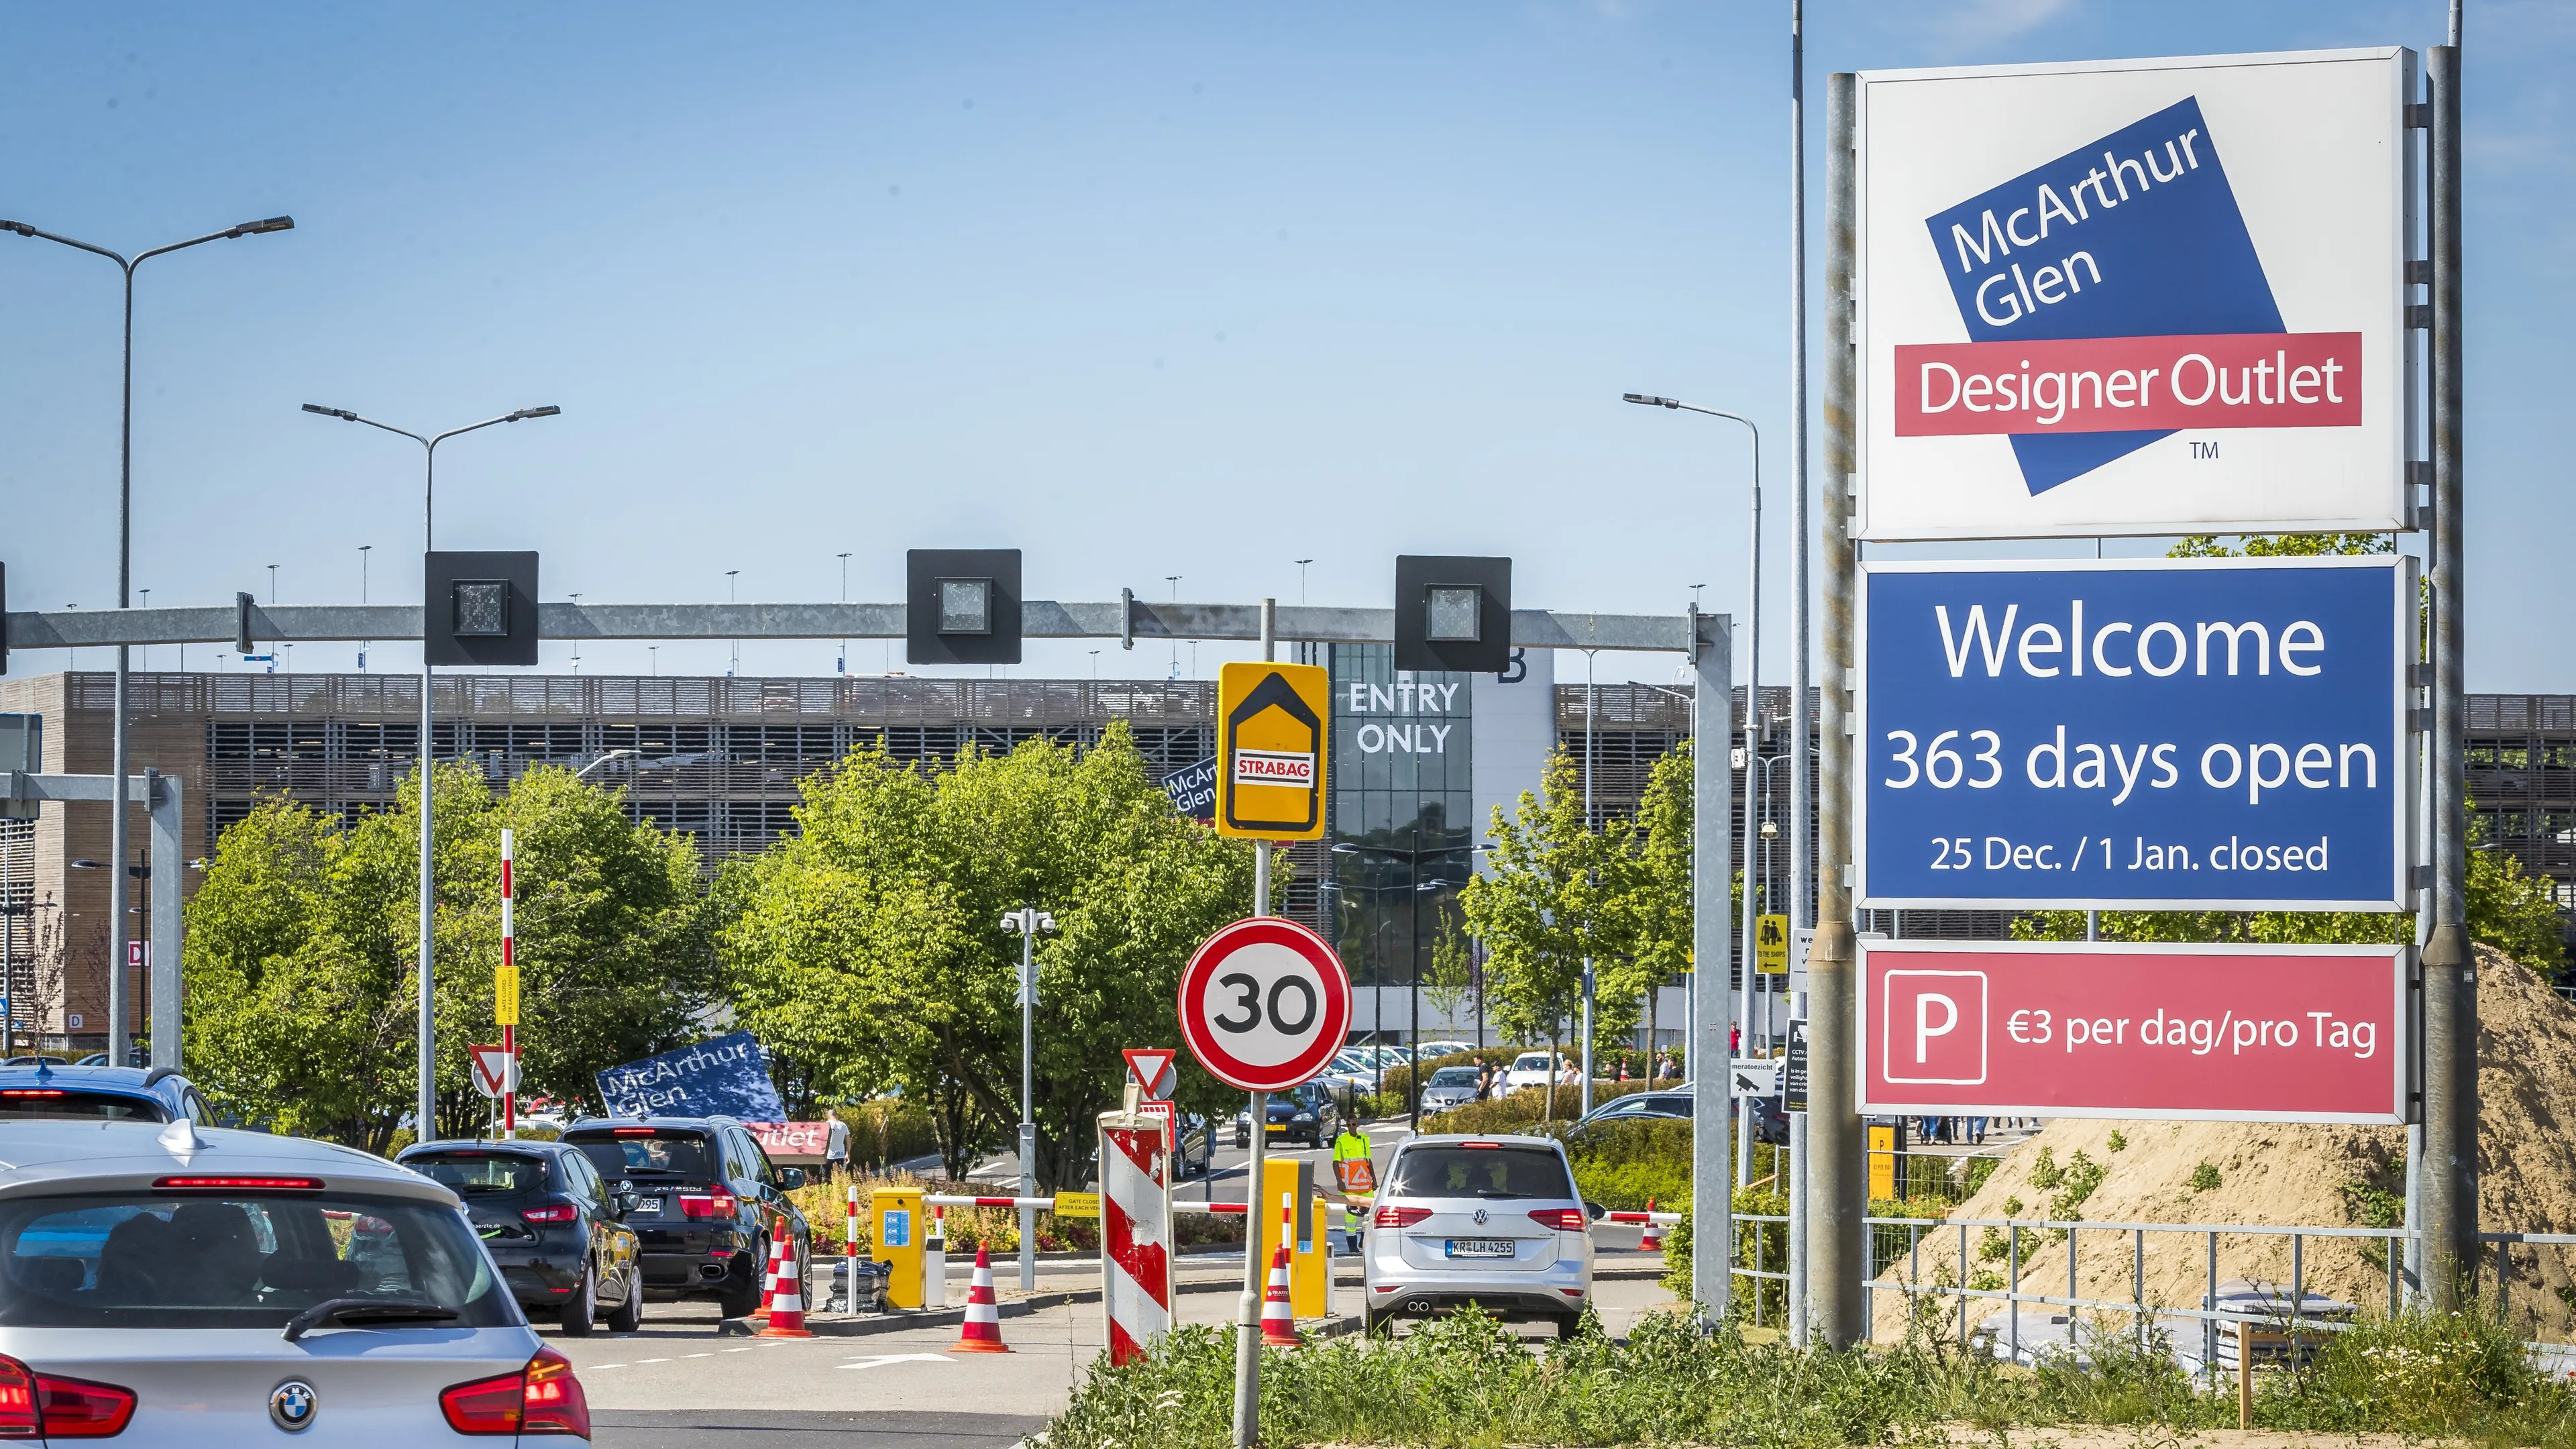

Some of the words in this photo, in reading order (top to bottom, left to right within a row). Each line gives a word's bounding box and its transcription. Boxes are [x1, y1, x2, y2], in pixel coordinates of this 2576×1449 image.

[1951, 128, 2199, 274] McArthur
[1976, 250, 2102, 327] Glen
[1921, 359, 2159, 425] Designer
[2170, 350, 2343, 407] Outlet
[2189, 441, 2219, 460] TM
[1935, 599, 2325, 678] Welcome
[1350, 683, 1459, 712] ENTRY
[1357, 724, 1452, 753] ONLY
[1169, 763, 1218, 796] McArt
[1239, 759, 1310, 777] STRABAG
[1884, 729, 2002, 789] 363
[2026, 725, 2178, 807] days
[2200, 742, 2377, 805] open
[1176, 788, 1216, 812] Glen
[1930, 838, 1972, 871] 25
[1986, 838, 2062, 871] Dec.
[2071, 836, 2087, 873] /
[2100, 838, 2112, 870] 1
[2127, 837, 2199, 871] Jan.
[2210, 836, 2328, 871] closed
[1213, 973, 1318, 1036] 30
[72, 1016, 80, 1027] D
[1916, 993, 1958, 1064] P
[2006, 1010, 2053, 1045] €3
[2066, 1014, 2130, 1053] per
[2140, 1008, 2299, 1055] dag/pro
[2307, 1012, 2377, 1059] Tag
[607, 1042, 747, 1097] McArthur
[616, 1085, 687, 1117] Glen
[752, 1126, 818, 1146] utlet
[1453, 1242, 1466, 1252] KR
[1473, 1242, 1486, 1252] LH
[1488, 1242, 1512, 1253] 4255
